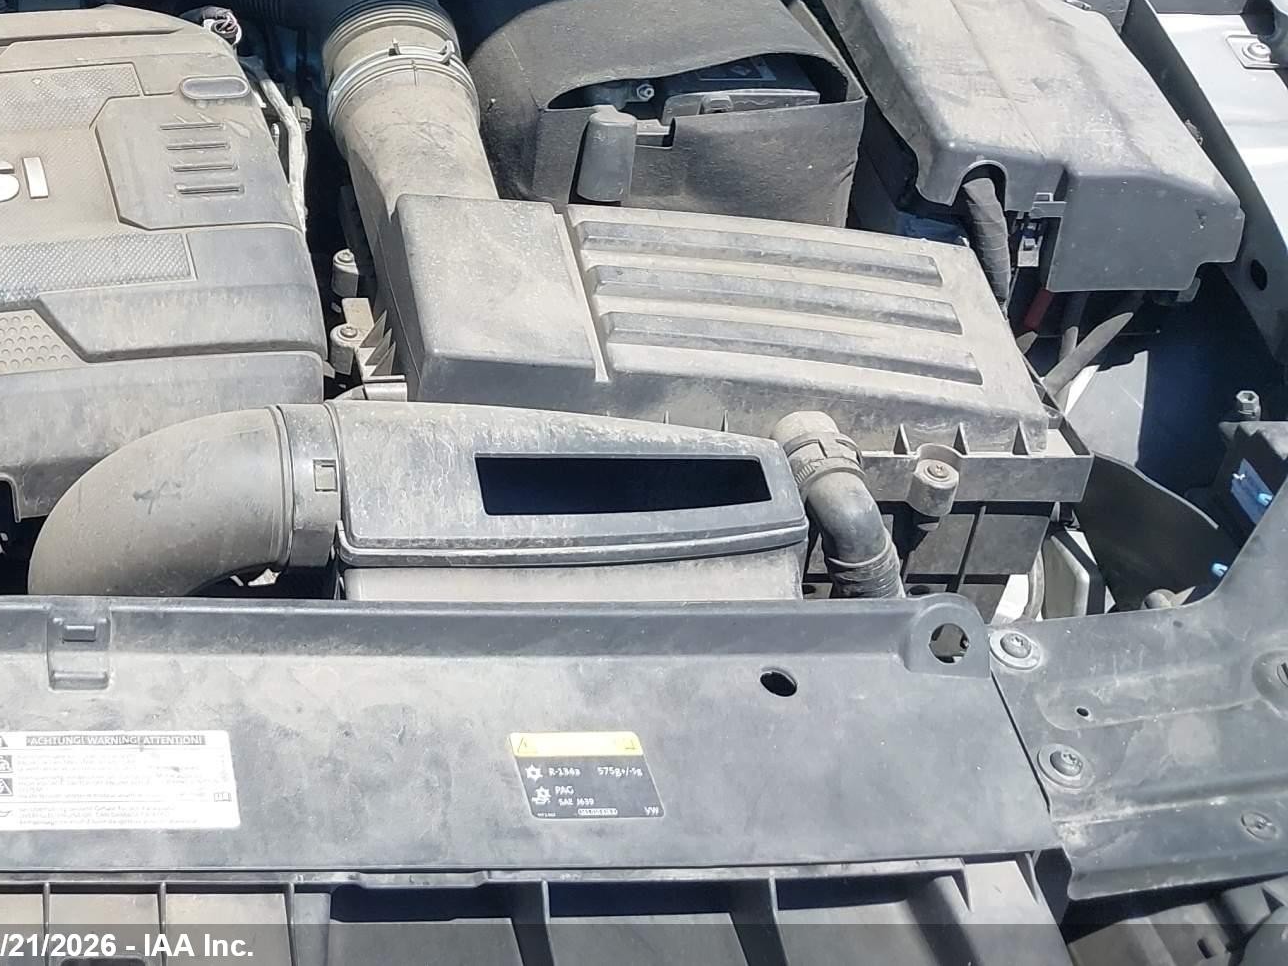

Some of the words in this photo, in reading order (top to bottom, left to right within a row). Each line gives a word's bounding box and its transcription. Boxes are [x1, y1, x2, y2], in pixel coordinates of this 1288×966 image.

[30, 736, 84, 745] ACHTUNG!
[143, 736, 203, 745] ATTENTION!
[554, 785, 575, 795] PAG
[558, 797, 574, 806] SAE
